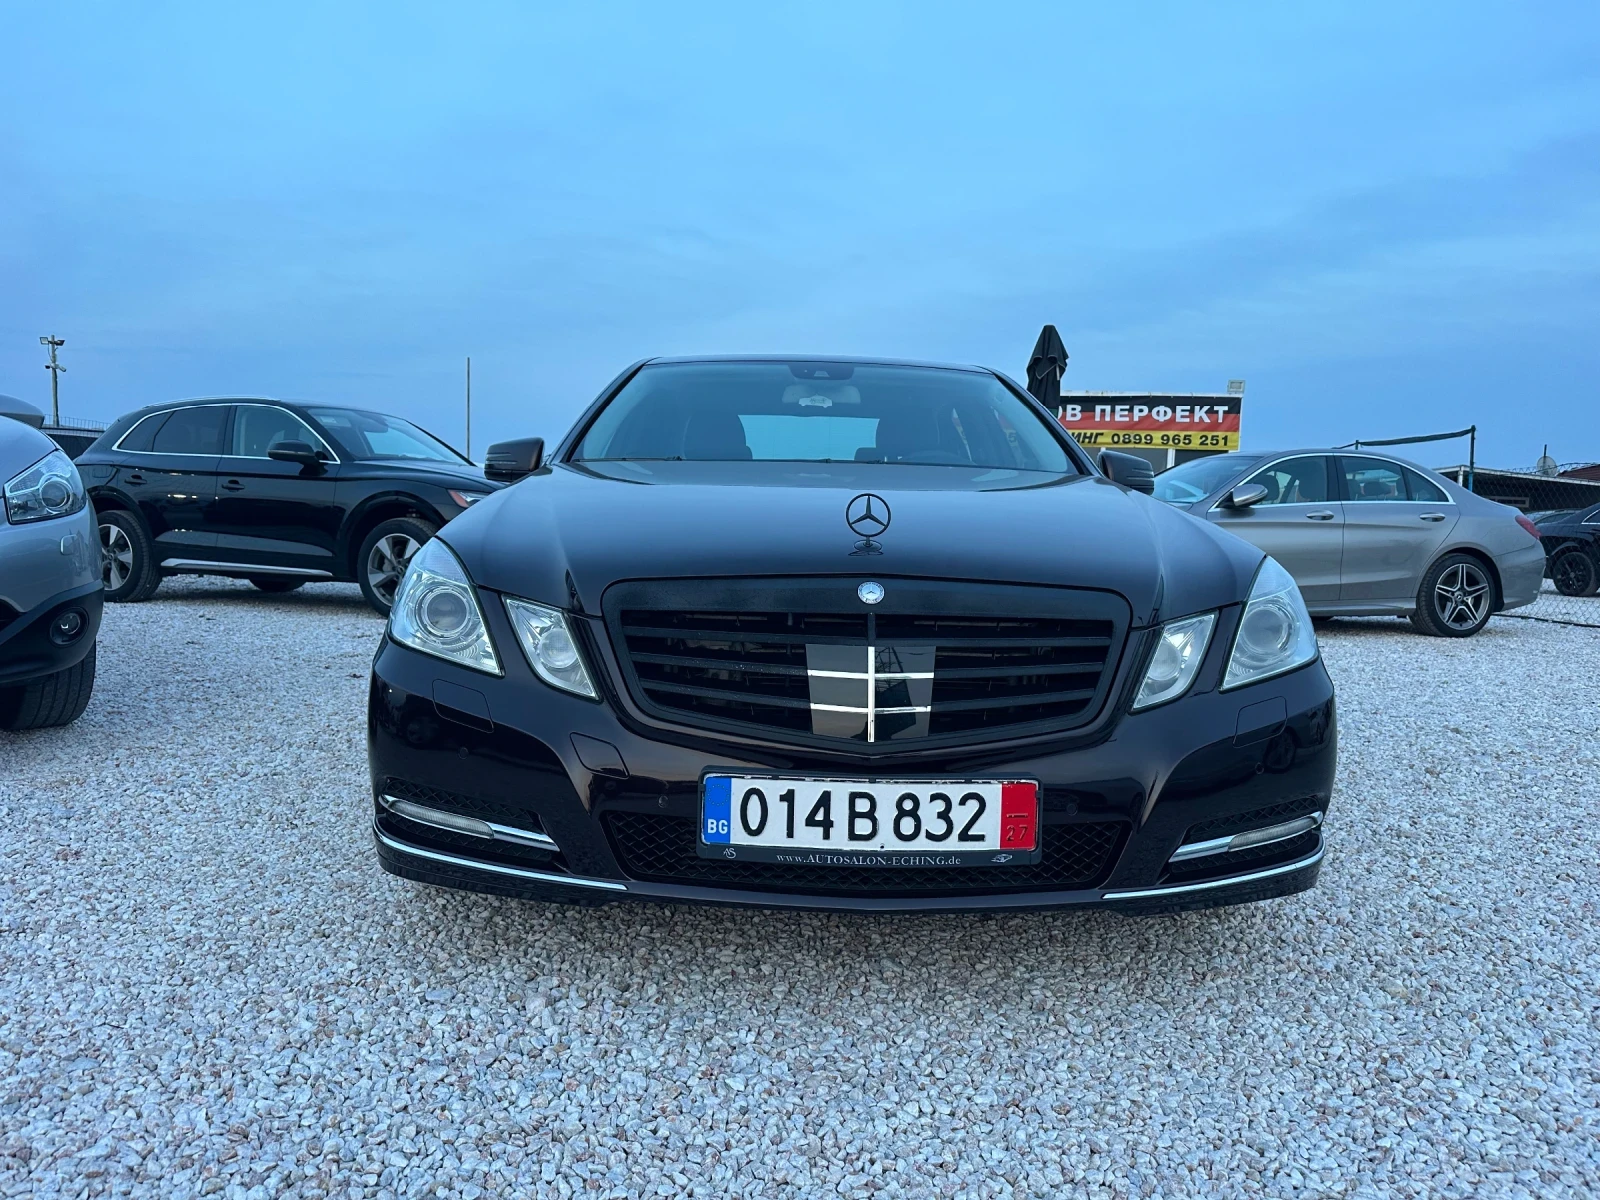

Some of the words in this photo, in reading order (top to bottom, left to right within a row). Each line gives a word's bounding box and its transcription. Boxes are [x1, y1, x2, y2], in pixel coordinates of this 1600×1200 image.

[1095, 404, 1229, 423] ПЕРФЕКТ
[1111, 433, 1154, 445] 0899
[1161, 434, 1192, 446] 965
[1199, 435, 1229, 446] 251
[707, 819, 728, 834] BG
[1006, 825, 1028, 841] 27
[776, 854, 962, 866] www.AUTOSALON-ECHING.de
